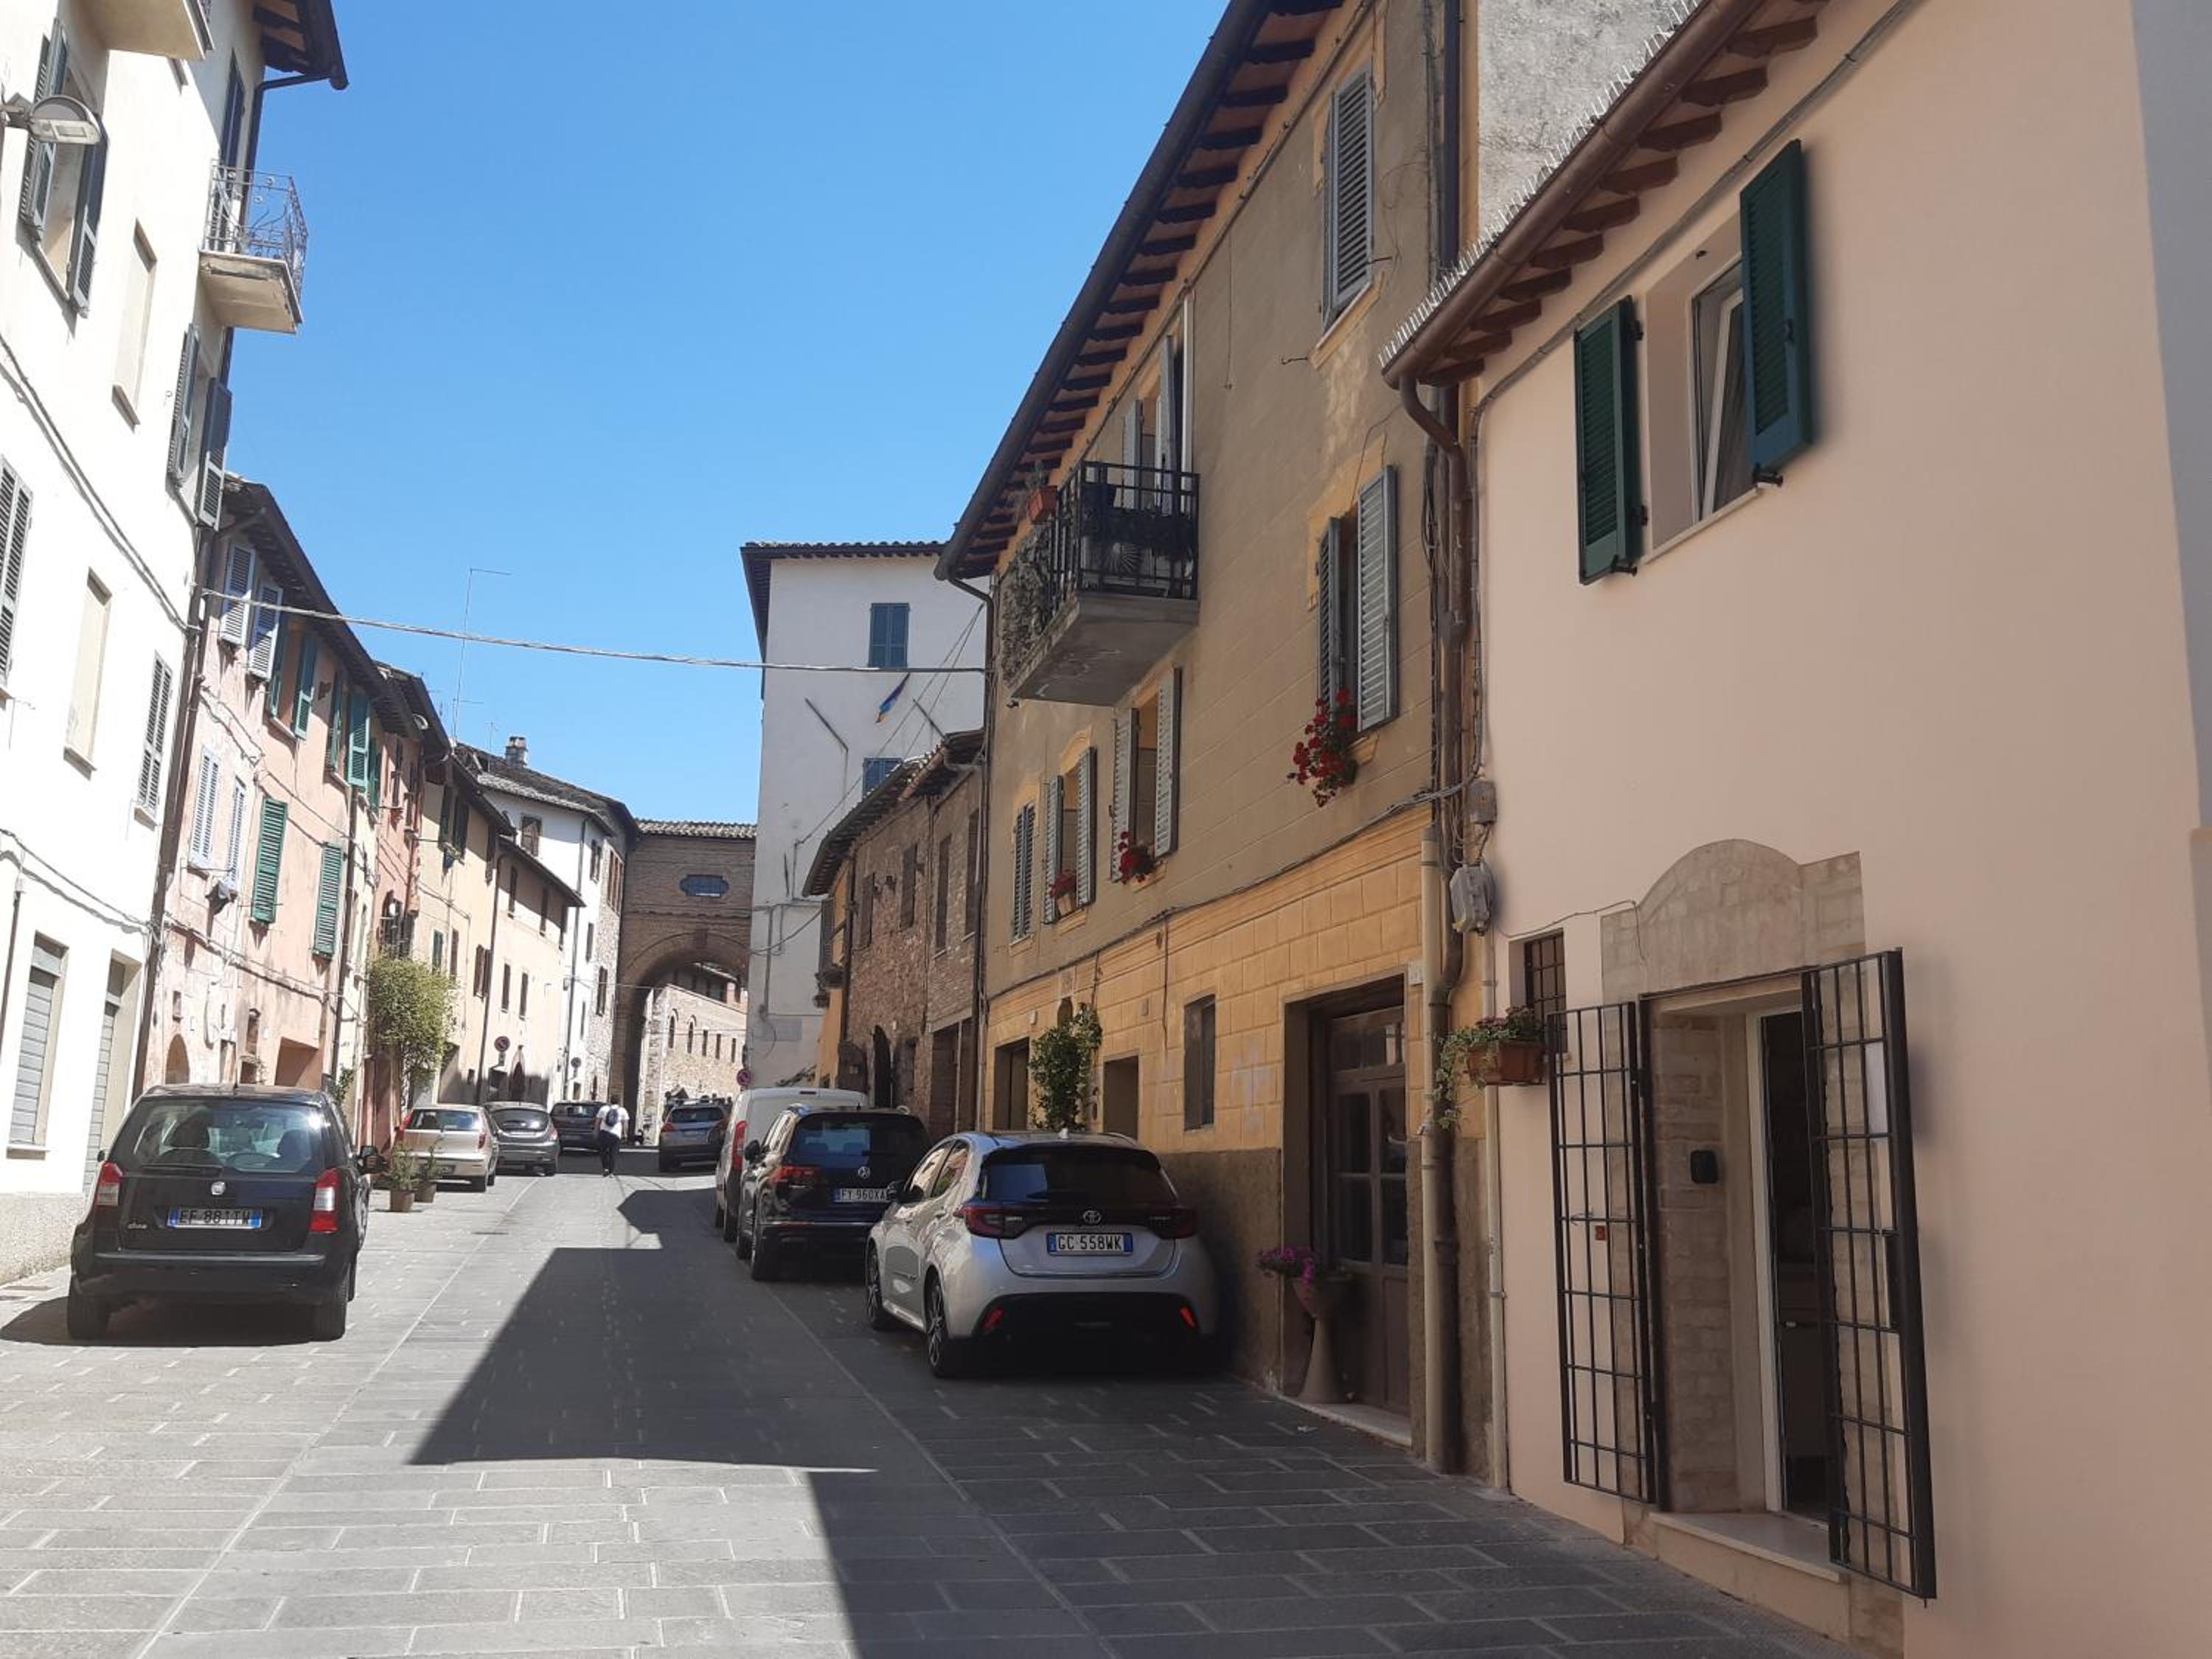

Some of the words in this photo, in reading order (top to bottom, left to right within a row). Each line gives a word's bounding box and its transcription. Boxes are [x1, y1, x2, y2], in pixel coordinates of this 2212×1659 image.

[179, 1209, 198, 1225] EF
[1058, 1235, 1074, 1250] GC
[1079, 1235, 1121, 1250] 558WK
